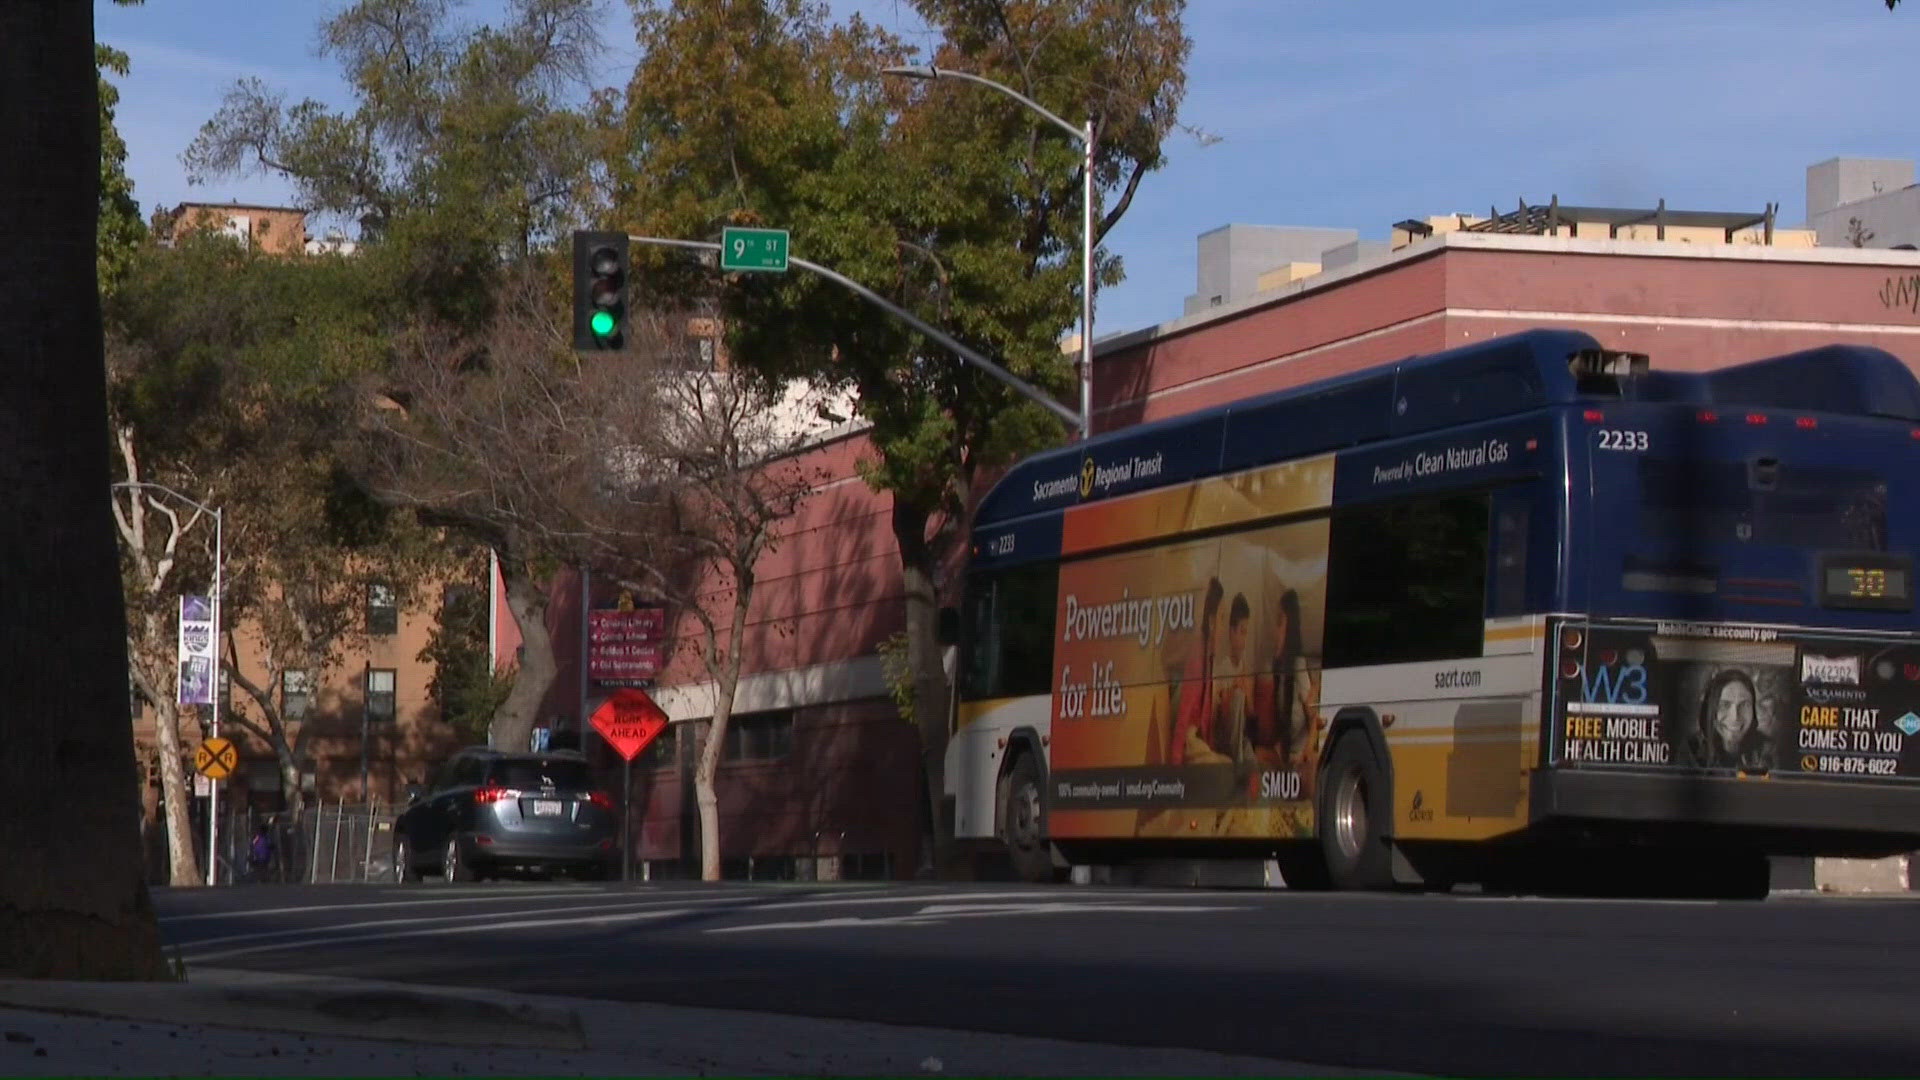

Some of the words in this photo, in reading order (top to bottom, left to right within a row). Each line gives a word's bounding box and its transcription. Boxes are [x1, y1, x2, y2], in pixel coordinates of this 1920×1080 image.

[765, 239, 778, 252] ST
[1599, 429, 1650, 451] 2233
[1373, 461, 1404, 483] Powered
[1404, 460, 1414, 480] by
[1415, 451, 1444, 476] Clean
[1446, 440, 1487, 470] Natural
[1488, 438, 1508, 463] Gas
[1033, 474, 1079, 501] Sacramento
[1094, 457, 1133, 491] Regional
[1134, 451, 1163, 479] Transit
[999, 533, 1016, 554] 2233
[1847, 568, 1885, 597] 30
[1063, 587, 1153, 647] Powering
[1153, 592, 1194, 645] you
[1059, 663, 1088, 720] for
[1090, 660, 1127, 717] life.
[1434, 668, 1482, 689] sacrt.com
[1580, 663, 1648, 703] W3
[1565, 716, 1603, 738] FREE
[1606, 718, 1661, 740] MOBILE
[1800, 706, 1840, 727] CARE
[1842, 707, 1880, 730] THAT
[610, 727, 647, 738] AHEAD
[1799, 728, 1849, 750] COMES
[1851, 730, 1871, 751] TO
[1873, 732, 1904, 753] YOU
[199, 752, 207, 764] R
[225, 751, 233, 764] R
[1564, 738, 1621, 761] HEALTH
[1623, 741, 1671, 763] CLINIC
[1260, 770, 1301, 798] SMUD
